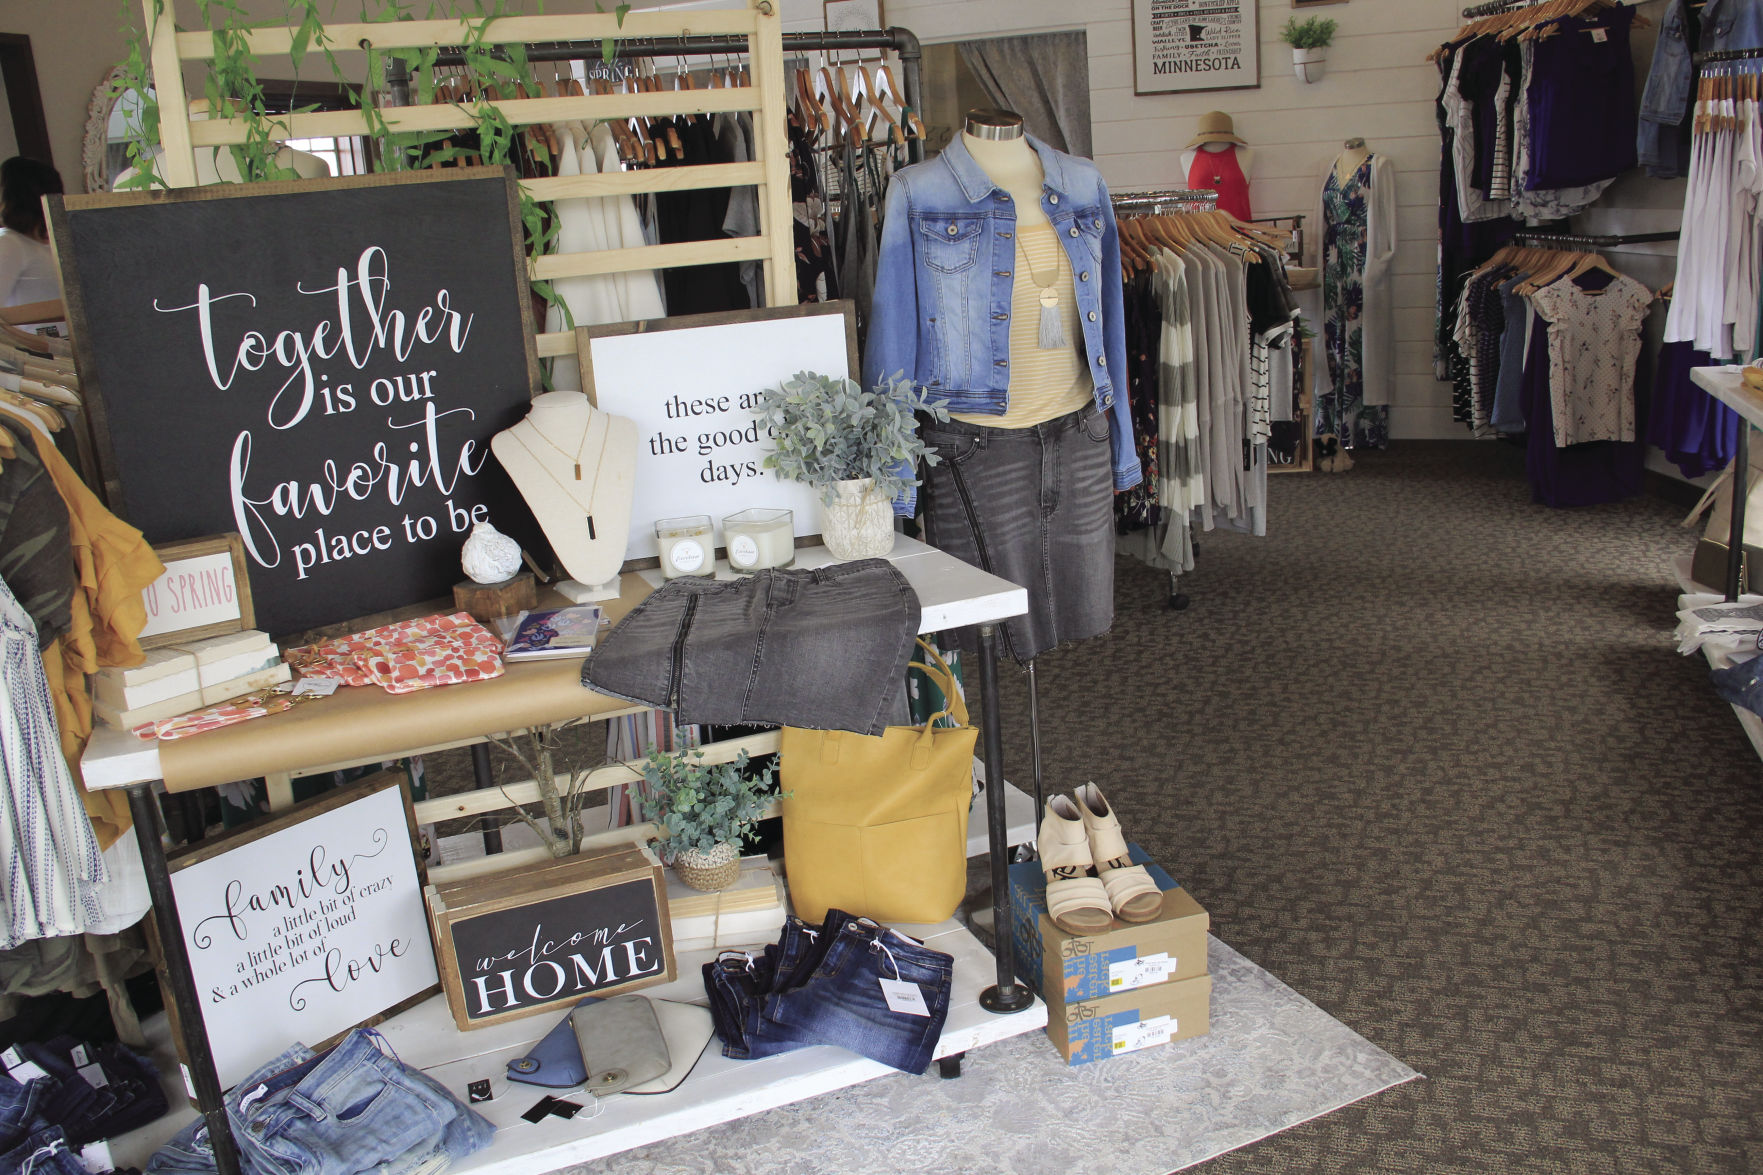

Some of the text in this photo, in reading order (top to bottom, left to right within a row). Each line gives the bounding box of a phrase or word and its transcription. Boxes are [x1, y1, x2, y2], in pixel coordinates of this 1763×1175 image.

[1152, 52, 1181, 60] FAMILY
[1153, 56, 1242, 75] MINNESOTA
[154, 246, 474, 430] together
[319, 369, 437, 416] is our
[664, 391, 767, 419] these ar
[649, 431, 688, 456] the
[697, 419, 760, 456] good
[230, 401, 488, 568] favorite
[700, 459, 764, 486] days.
[291, 499, 490, 581] place to be
[166, 566, 234, 615] SPRING
[193, 828, 388, 950] family
[272, 874, 394, 938] a little bit of crazy
[211, 936, 328, 1004] & a whole lot of
[236, 905, 357, 974] a little bit of loud
[476, 919, 643, 972] welcome
[289, 937, 412, 1012] love
[470, 936, 659, 1015] HOME
